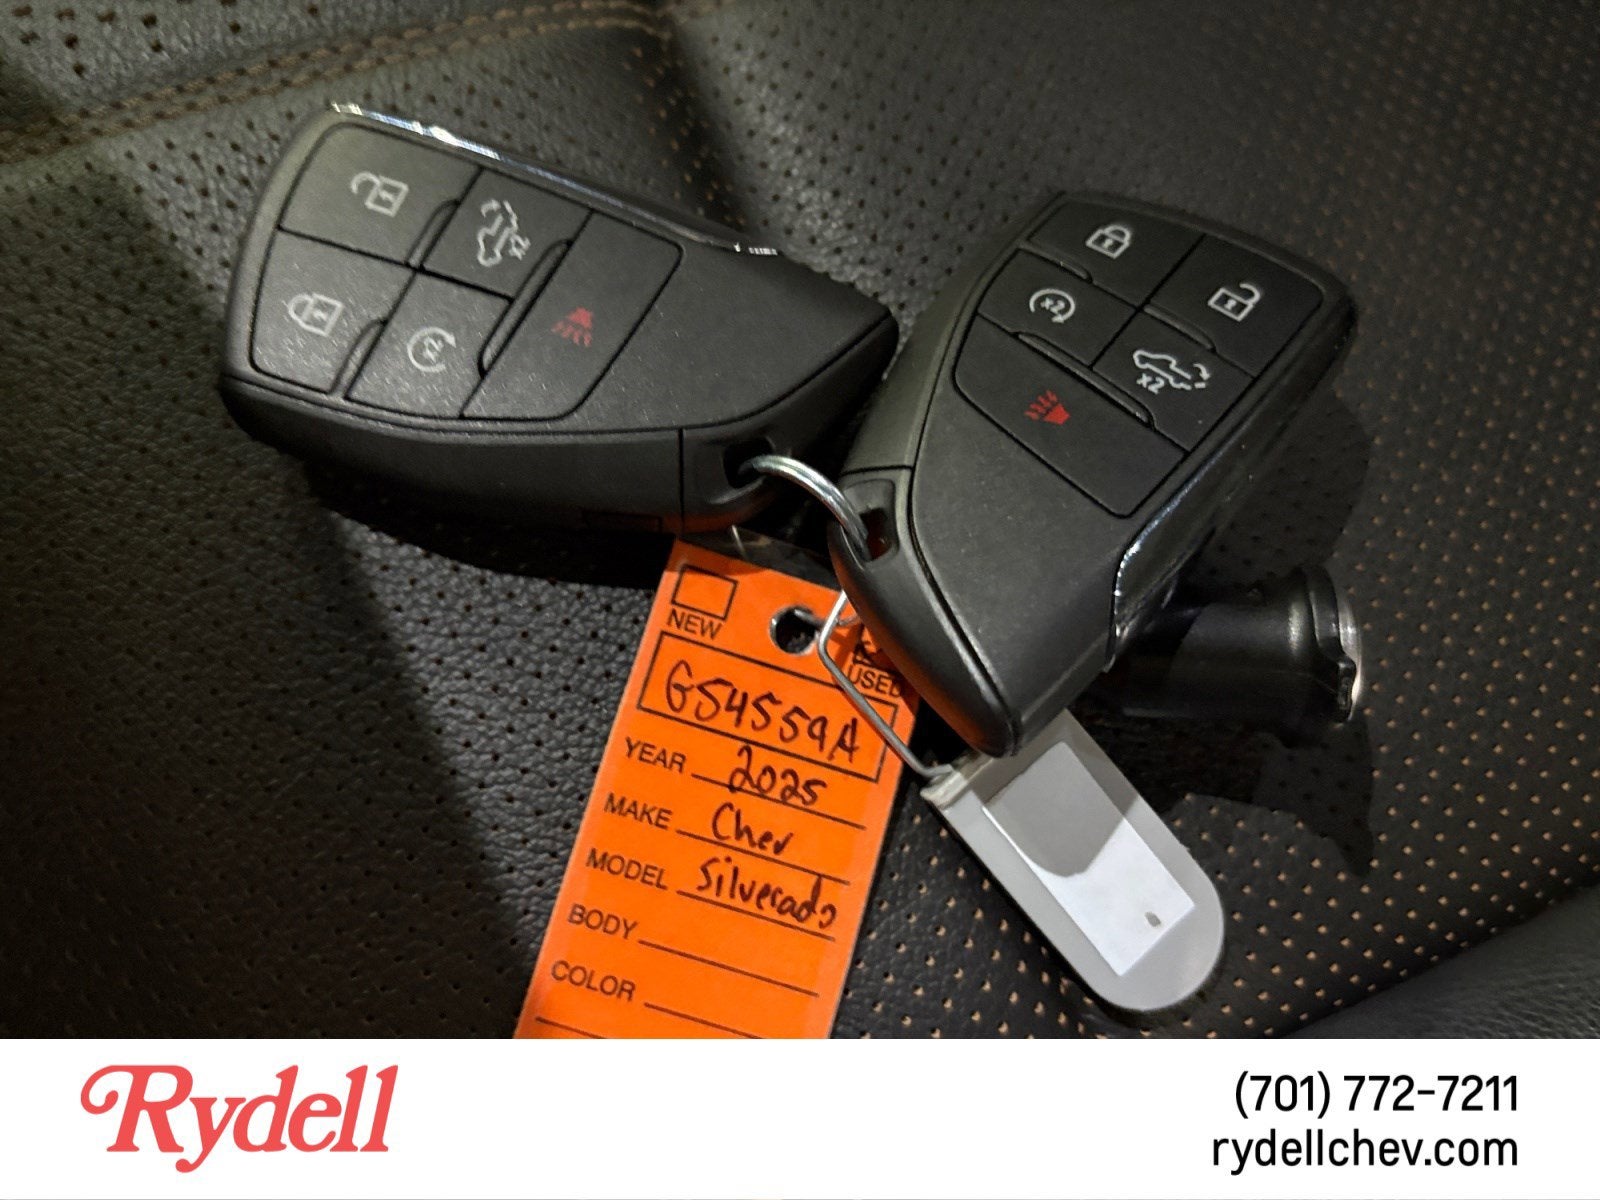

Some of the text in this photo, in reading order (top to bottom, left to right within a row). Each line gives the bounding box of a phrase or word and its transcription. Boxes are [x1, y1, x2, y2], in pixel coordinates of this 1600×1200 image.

[1040, 297, 1065, 314] x2
[1137, 373, 1164, 394] x2
[668, 610, 724, 639] NEW
[625, 736, 687, 773] YEAR
[728, 744, 828, 807] 2025
[603, 792, 672, 831] MAKE
[711, 801, 795, 856] Chev
[586, 848, 669, 891] MODEL
[697, 856, 837, 930] Silverado
[567, 903, 638, 941] BODY
[551, 960, 636, 1002] COLOR
